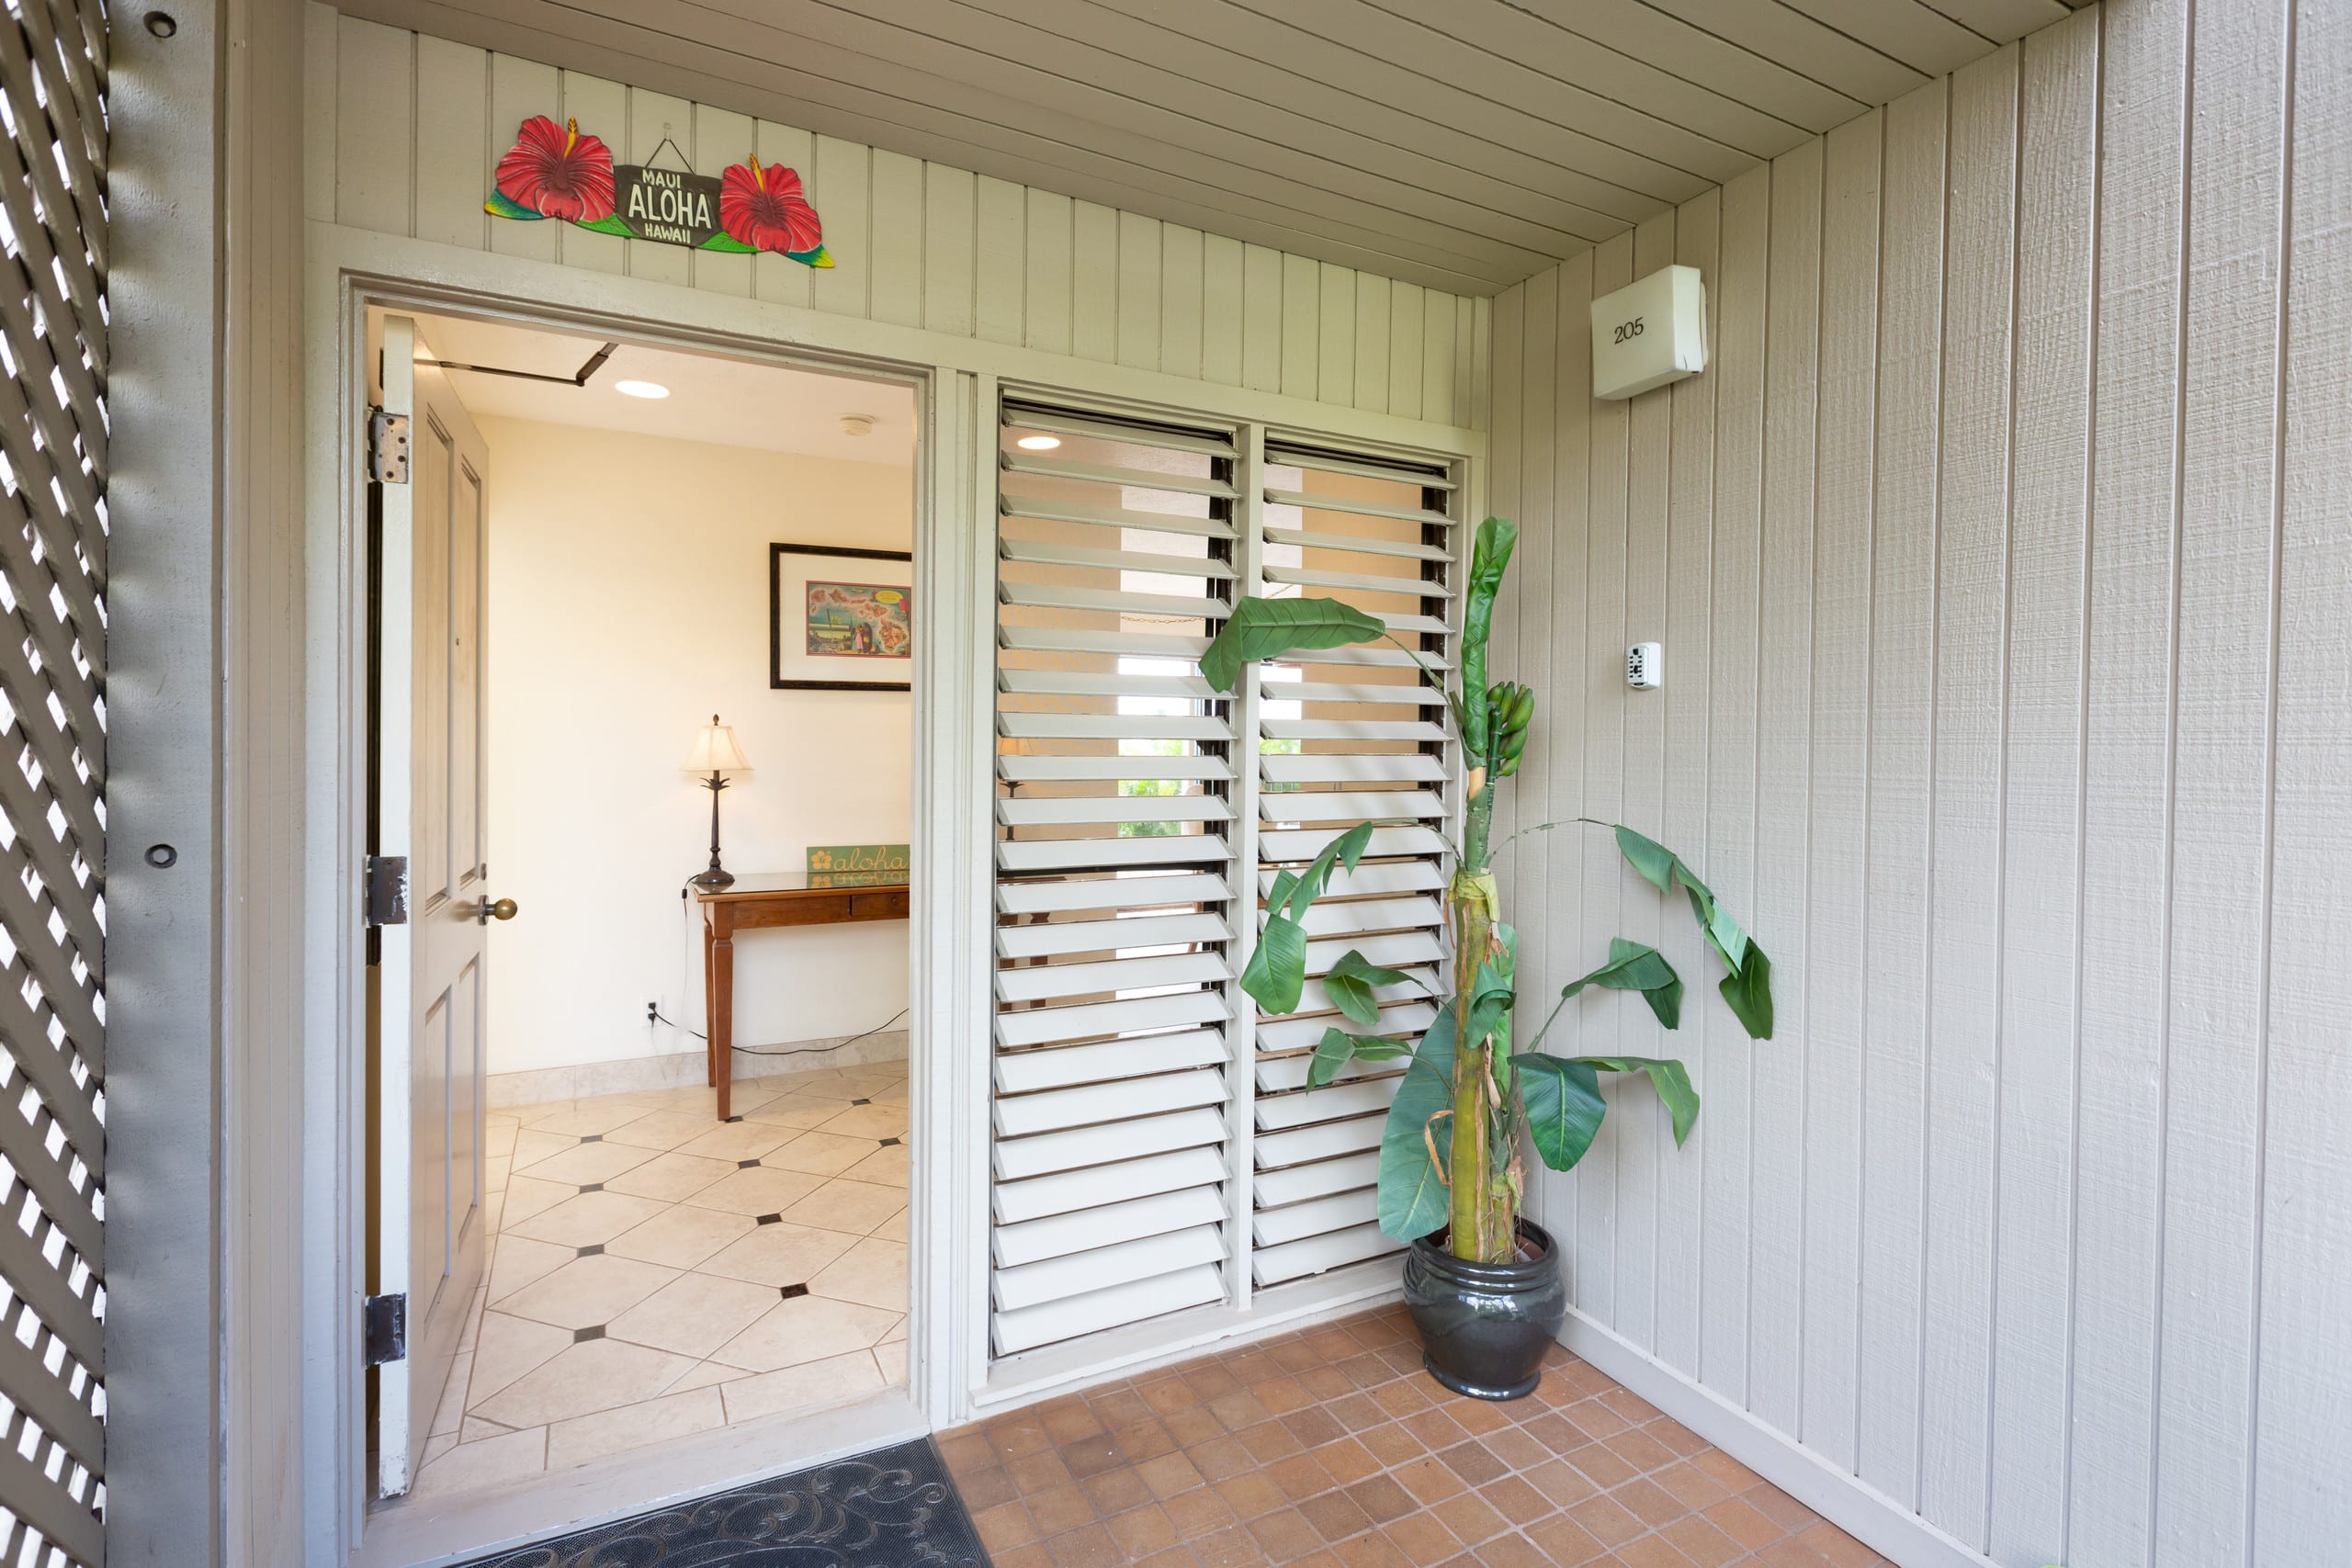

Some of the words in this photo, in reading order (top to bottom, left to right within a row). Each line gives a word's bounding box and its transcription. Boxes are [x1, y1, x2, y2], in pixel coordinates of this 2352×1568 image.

[642, 170, 681, 188] MAUI
[628, 184, 712, 229] ALOHA
[644, 223, 691, 243] HAWAII
[1614, 317, 1645, 344] 205
[834, 846, 908, 871] aloha
